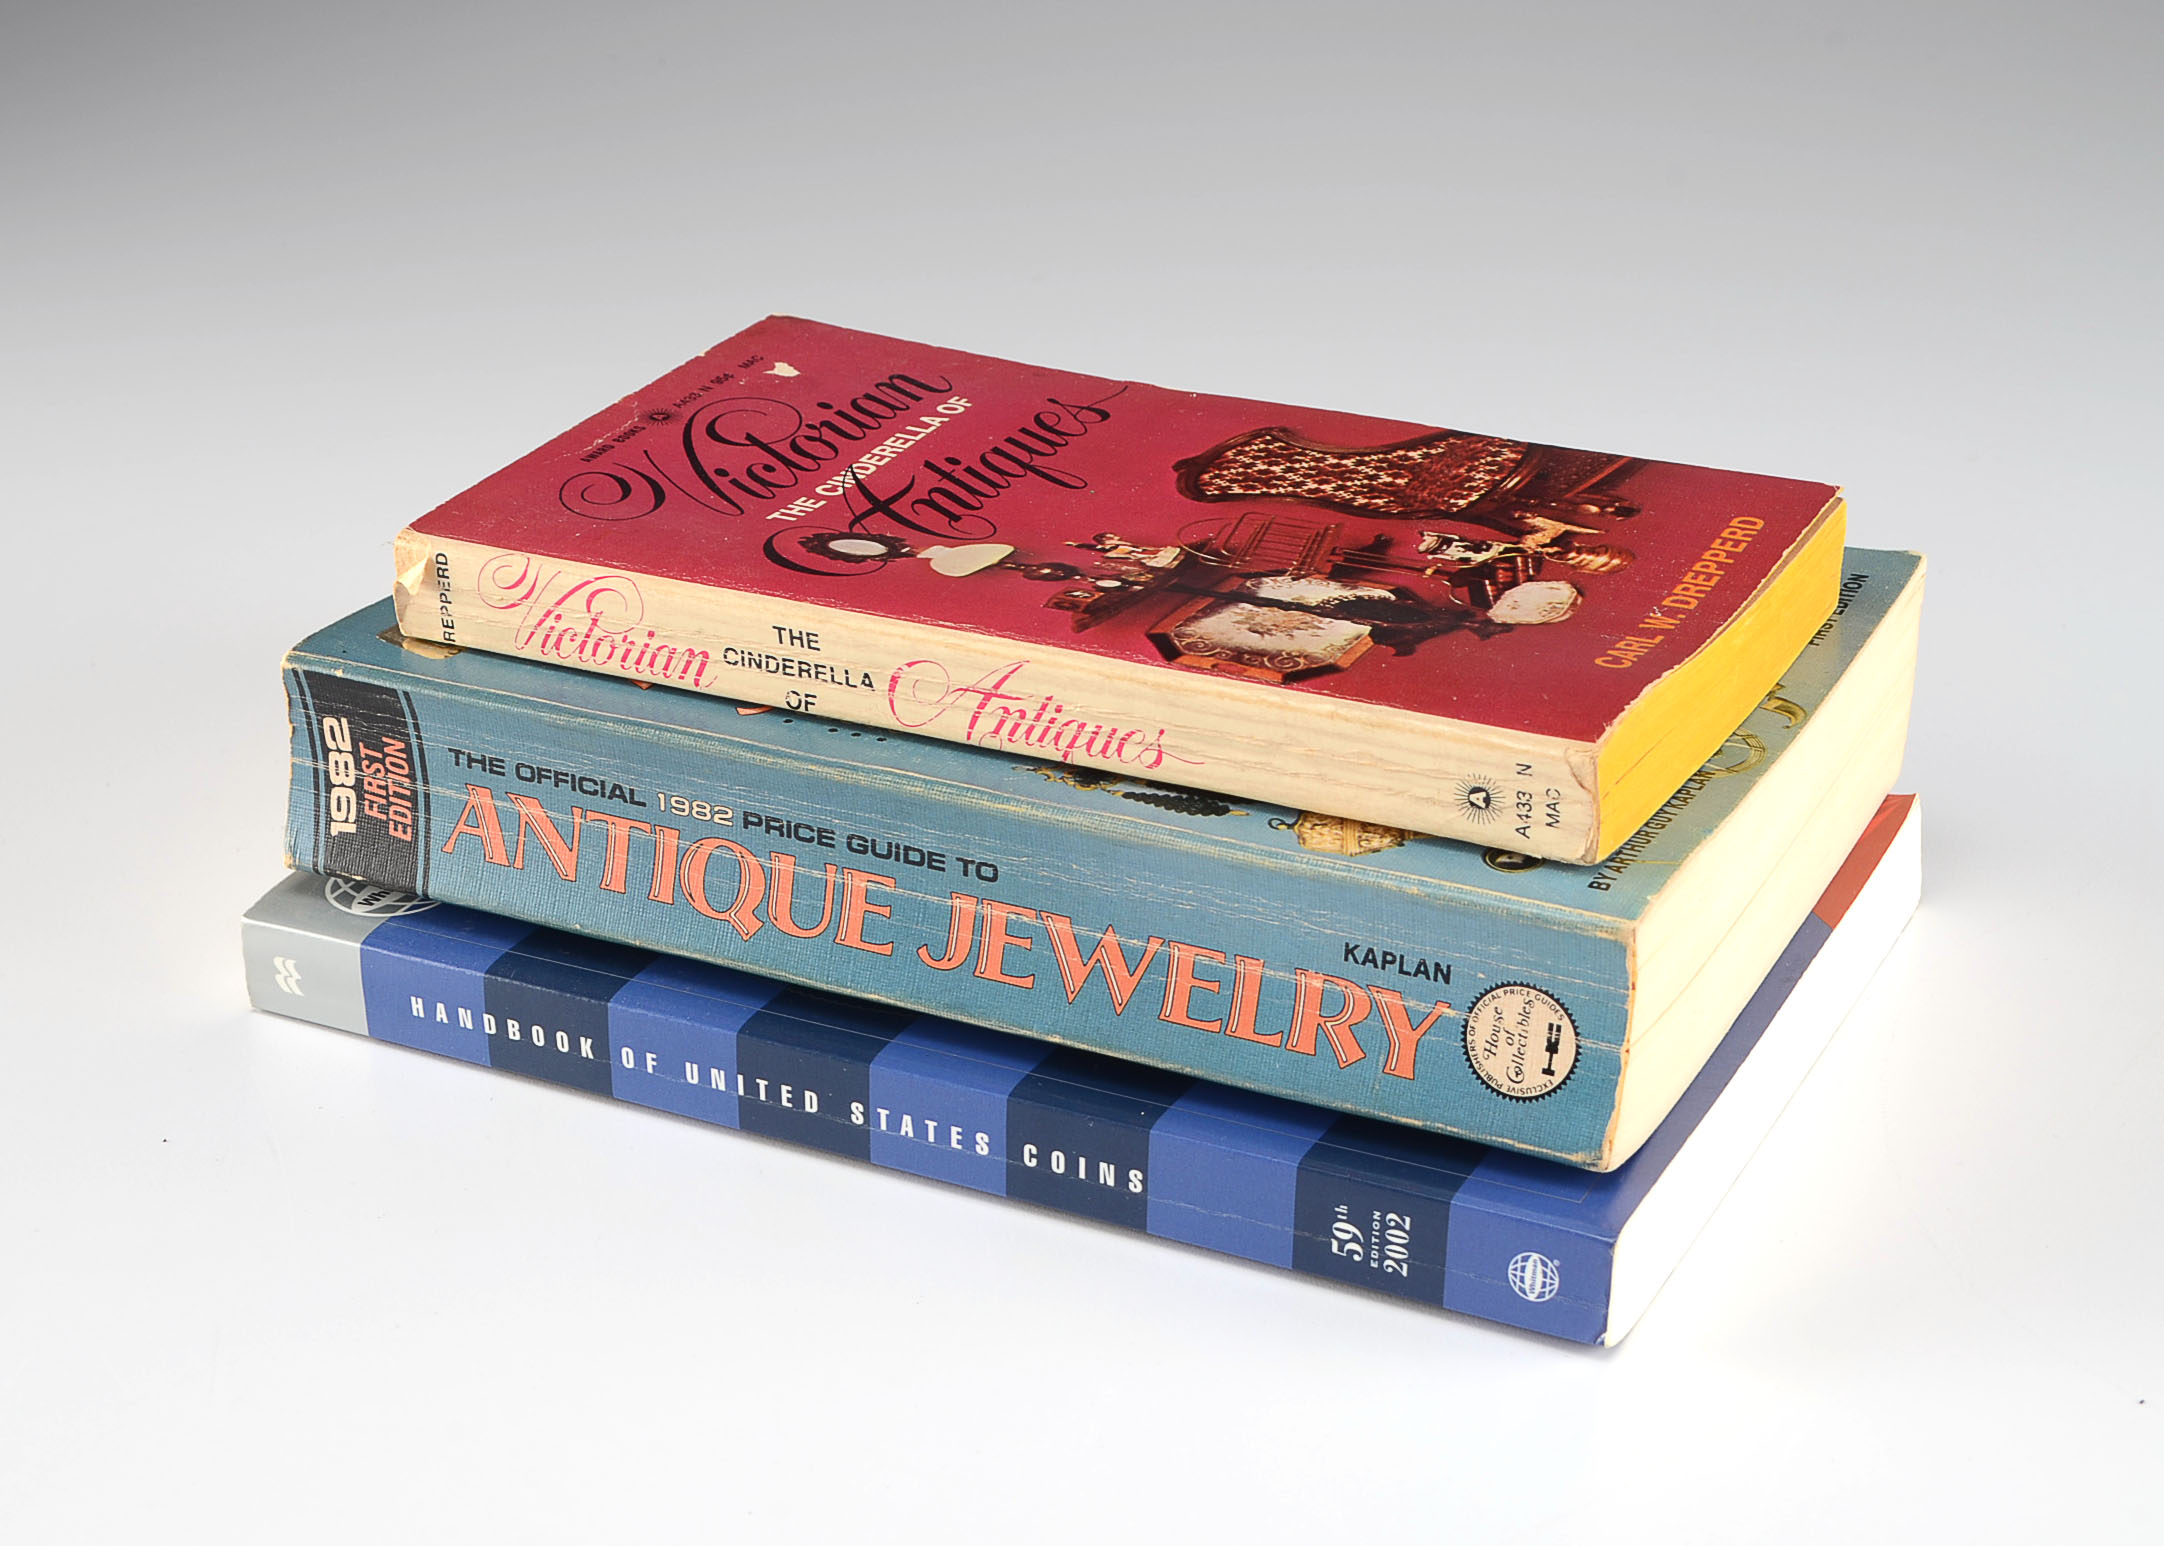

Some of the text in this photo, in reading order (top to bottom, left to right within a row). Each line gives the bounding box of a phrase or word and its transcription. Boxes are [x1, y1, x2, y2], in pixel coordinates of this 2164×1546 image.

[558, 373, 953, 521] Victorian
[612, 425, 646, 443] BOOKS
[765, 395, 974, 523] THE CINDERELLA OF
[762, 385, 1129, 577] Antiques
[477, 552, 719, 690] Victorian
[1594, 515, 1766, 669] CARL W. DREPPERD
[722, 646, 877, 692] CINDERELLA
[772, 624, 822, 652] THE
[785, 689, 819, 712] OF
[887, 658, 1206, 770] Antiques
[322, 716, 357, 837] 1982
[359, 742, 388, 821] FIRST
[381, 736, 413, 842] EDITION
[448, 747, 1000, 884] THE OFFICIAL 1982 PRICE GUIDE TO
[1515, 762, 1533, 840] A433 N
[1545, 788, 1561, 828] MAC
[1587, 770, 1717, 892] BY ARTHUR GUY KAPLAN
[440, 782, 1452, 1081] ANTIQUE JEWELRY
[1342, 941, 1453, 985] KAPLAN
[1468, 988, 1566, 1096] EXCLUSIVE PUBLISHERS OF OFFICIAL PRICE GUIDES
[1482, 1006, 1504, 1060] House
[1503, 1027, 1516, 1046] of
[1506, 998, 1535, 1084] Collectibles
[410, 995, 1144, 1194] HANDBOOK OF UNITED STATES COINS
[1331, 1204, 1364, 1262] 59th
[1370, 1210, 1382, 1269] EDITION
[1382, 1212, 1411, 1278] 2002
